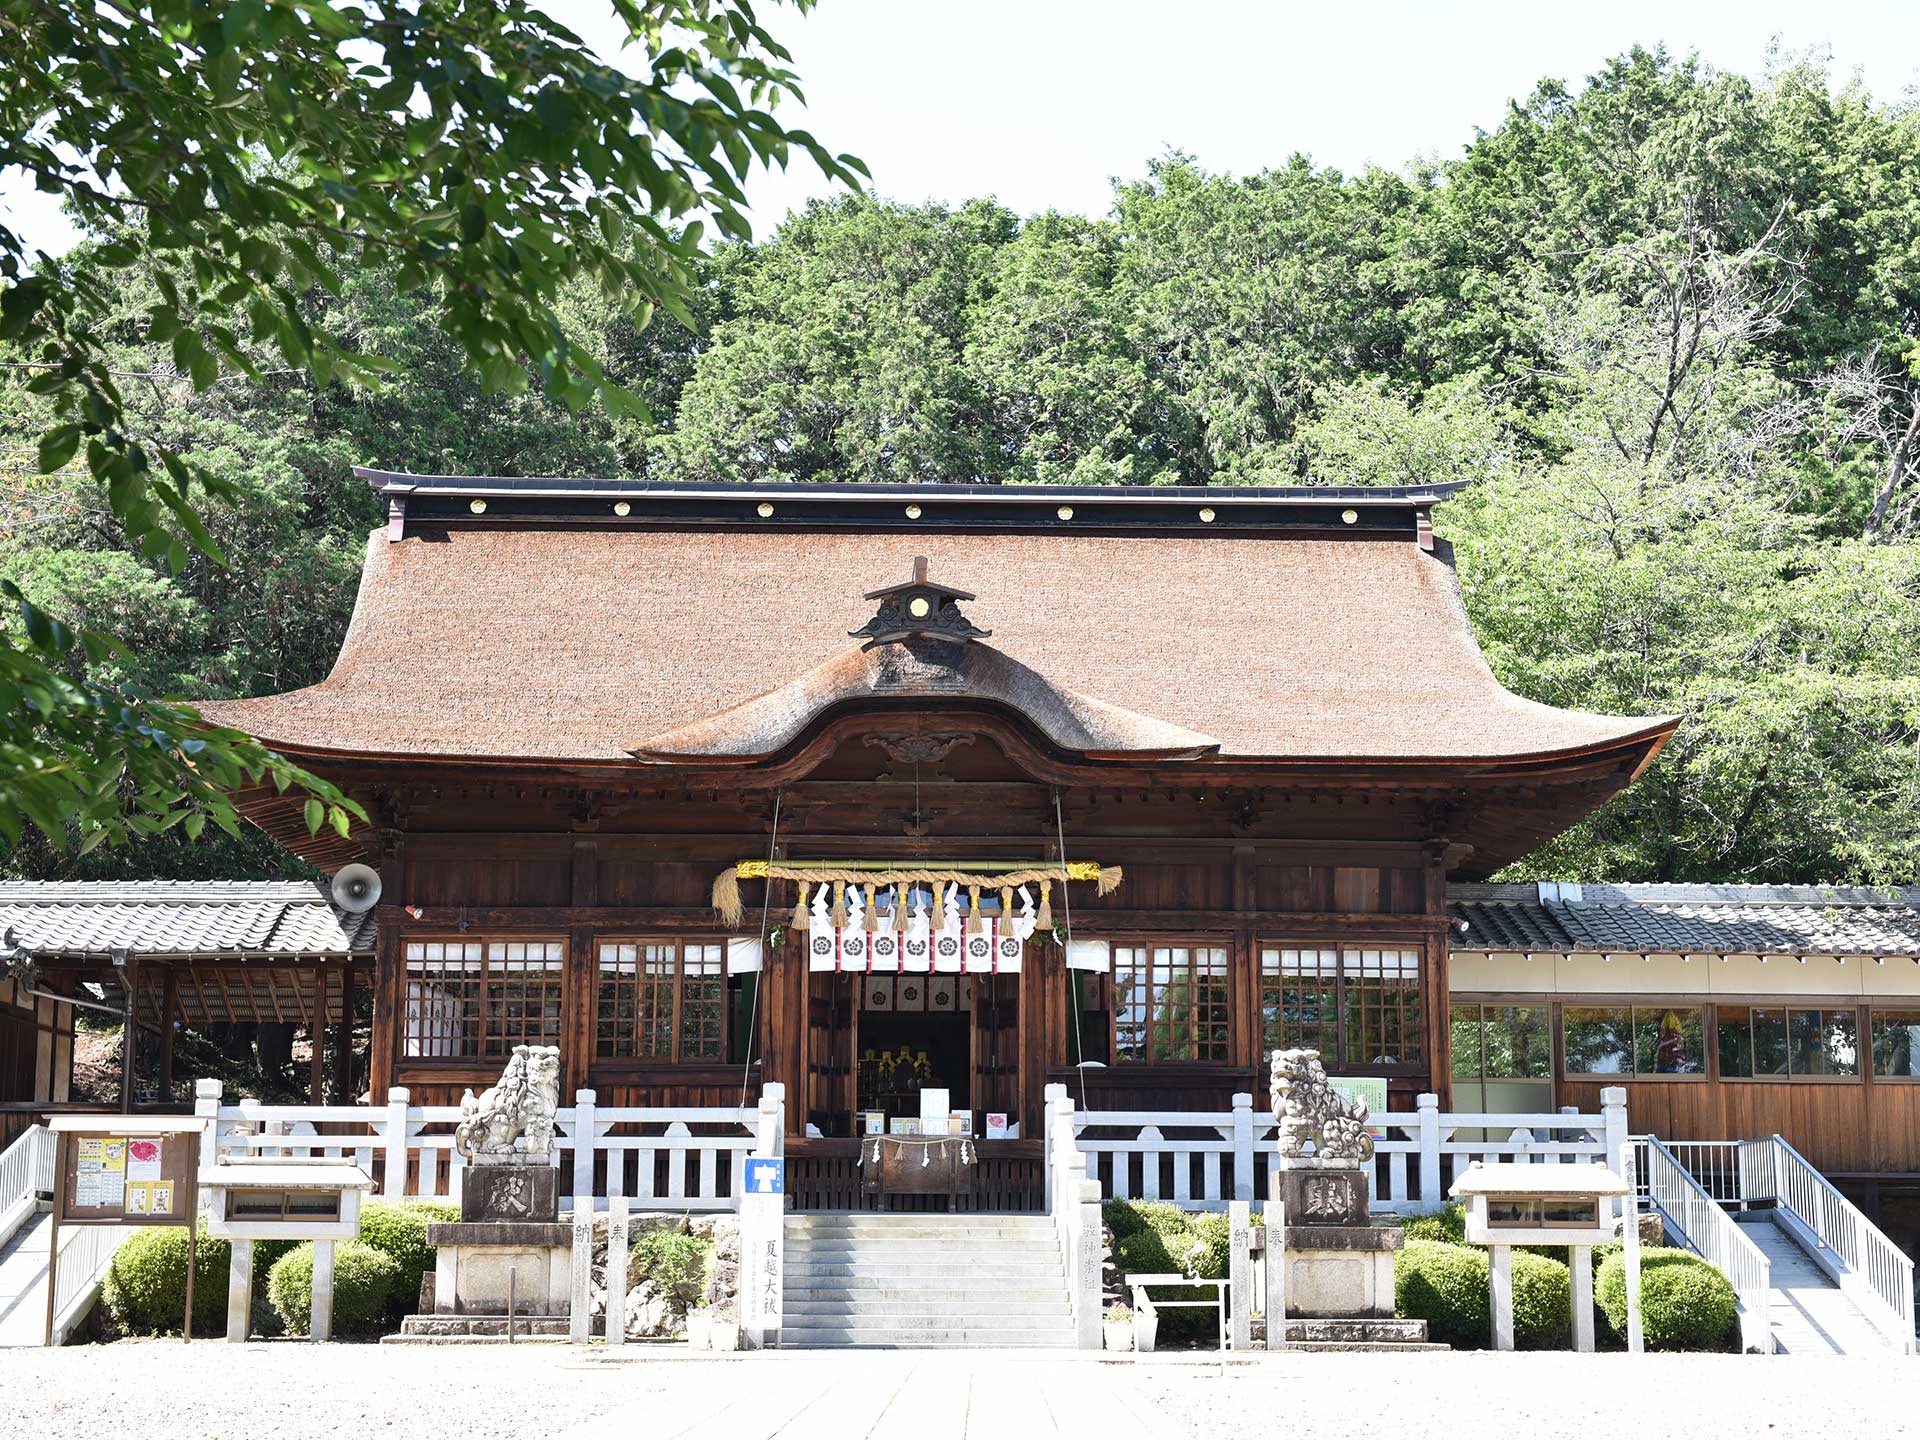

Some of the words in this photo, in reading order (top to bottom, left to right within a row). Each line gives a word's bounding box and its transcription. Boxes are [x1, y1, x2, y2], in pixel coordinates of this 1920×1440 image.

[575, 1223, 590, 1243] 納
[610, 1224, 625, 1241] 奉
[1233, 1228, 1248, 1248] 納
[1268, 1228, 1283, 1248] 奉
[763, 1240, 778, 1315] 夏越大祓
